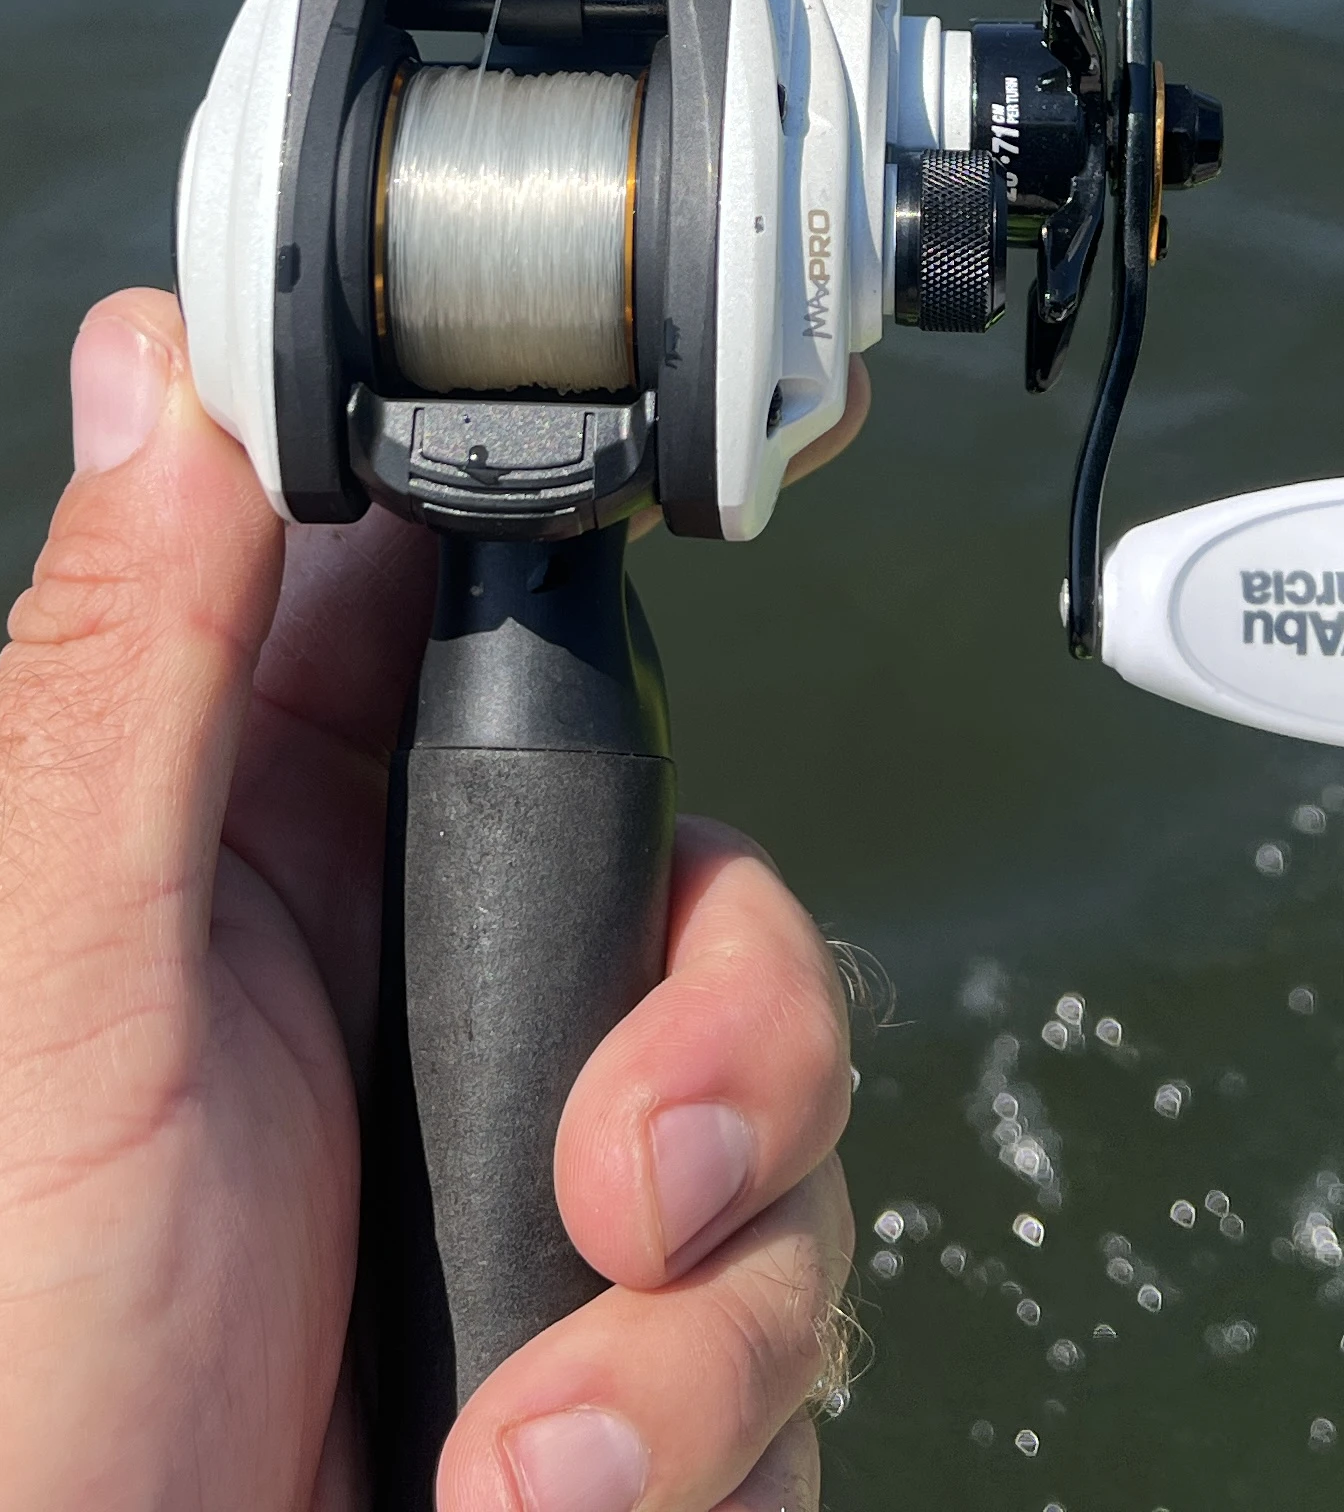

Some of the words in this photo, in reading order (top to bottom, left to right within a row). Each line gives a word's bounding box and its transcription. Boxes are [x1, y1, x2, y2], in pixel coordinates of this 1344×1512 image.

[1005, 76, 1019, 103] TURN
[991, 103, 1006, 124] CM
[1005, 103, 1020, 125] PER
